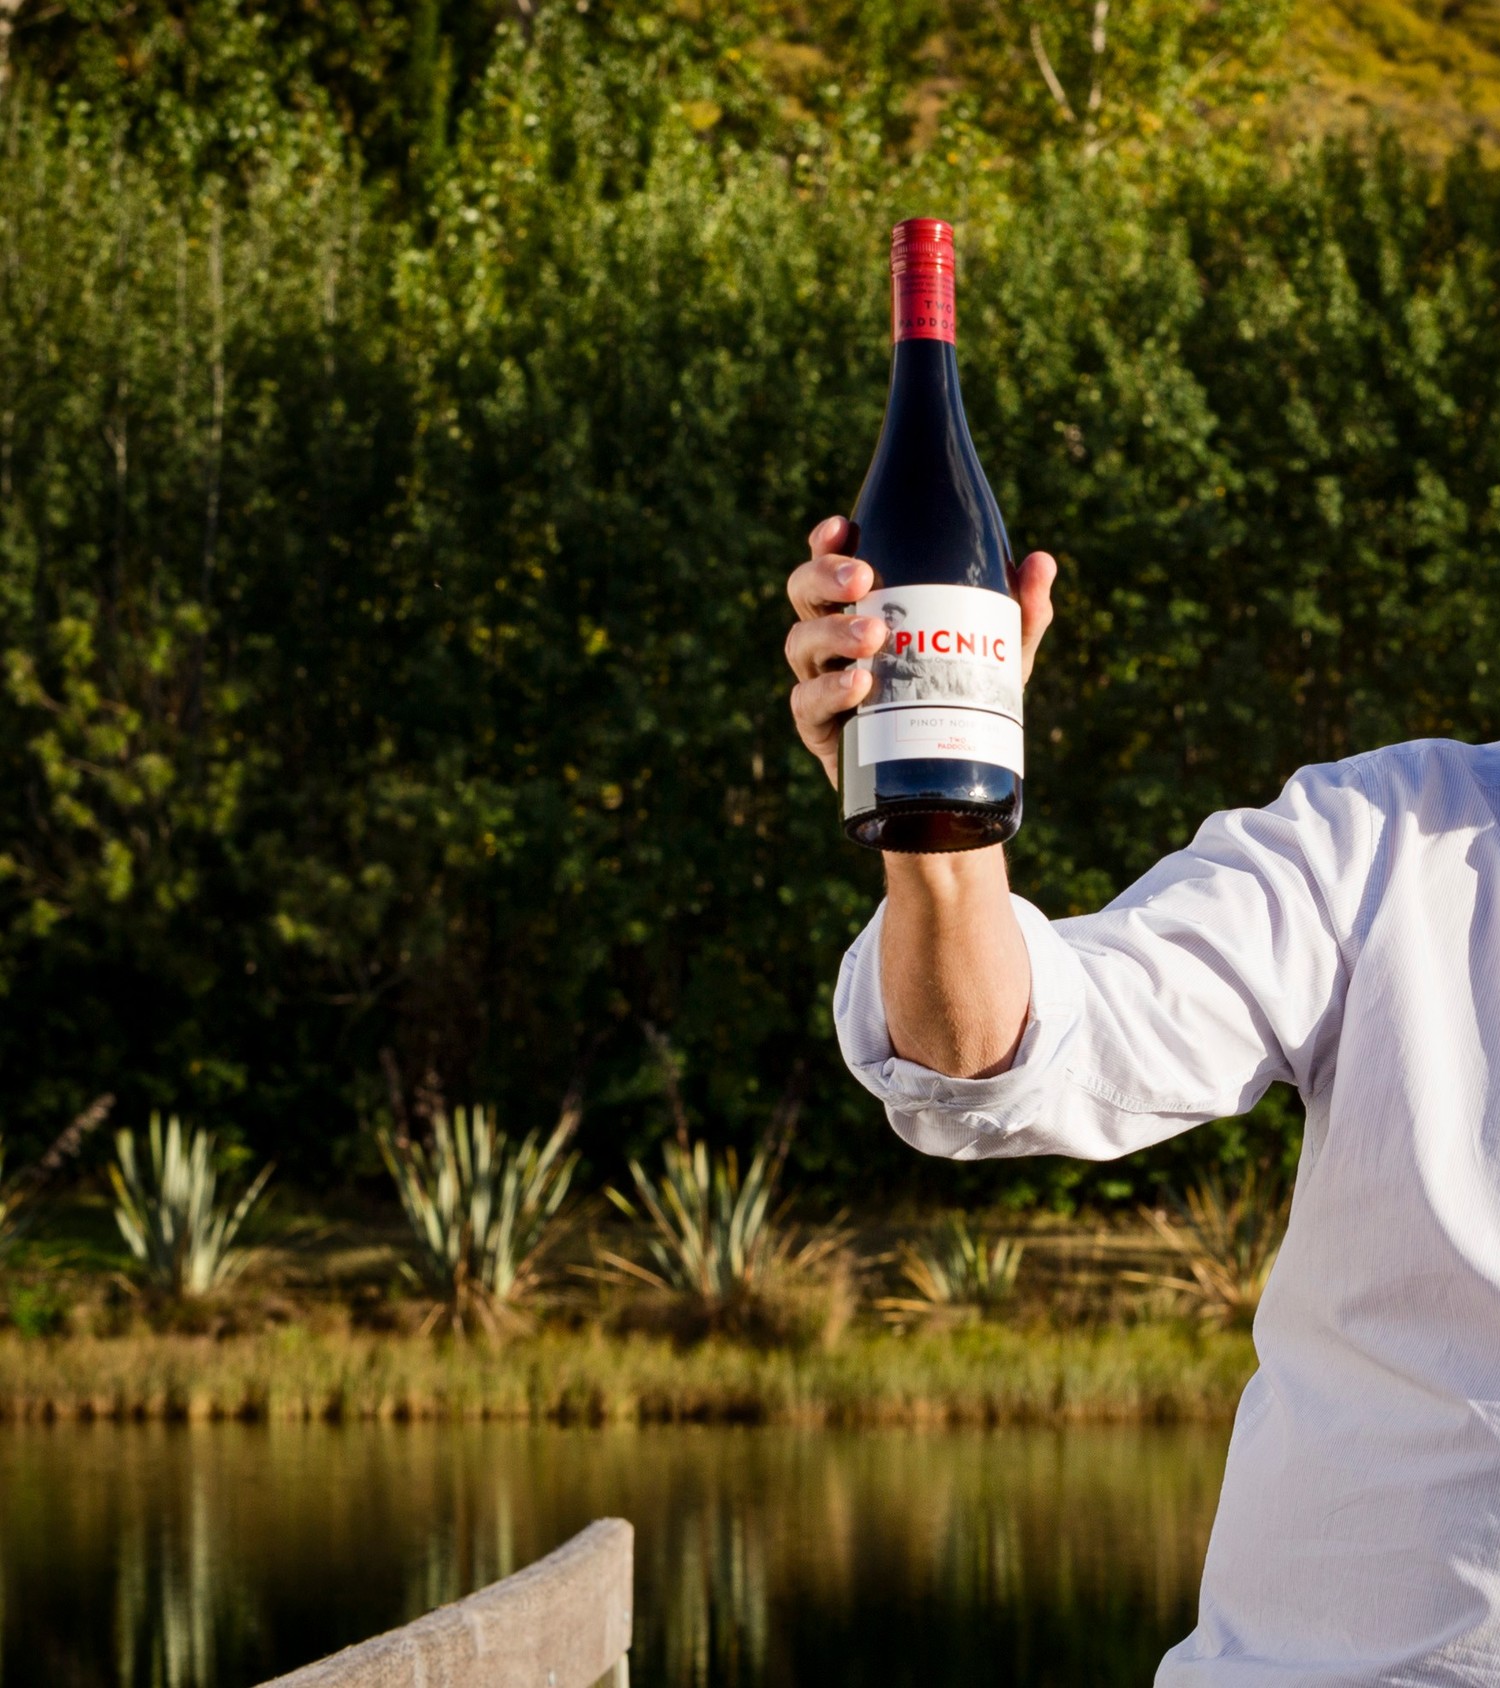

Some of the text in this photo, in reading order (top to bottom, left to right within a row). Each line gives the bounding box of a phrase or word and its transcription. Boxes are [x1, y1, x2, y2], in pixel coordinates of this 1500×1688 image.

[924, 300, 953, 314] TWO
[895, 630, 1006, 662] PICNIC
[910, 718, 945, 728] PINOT
[948, 736, 967, 744] TWO
